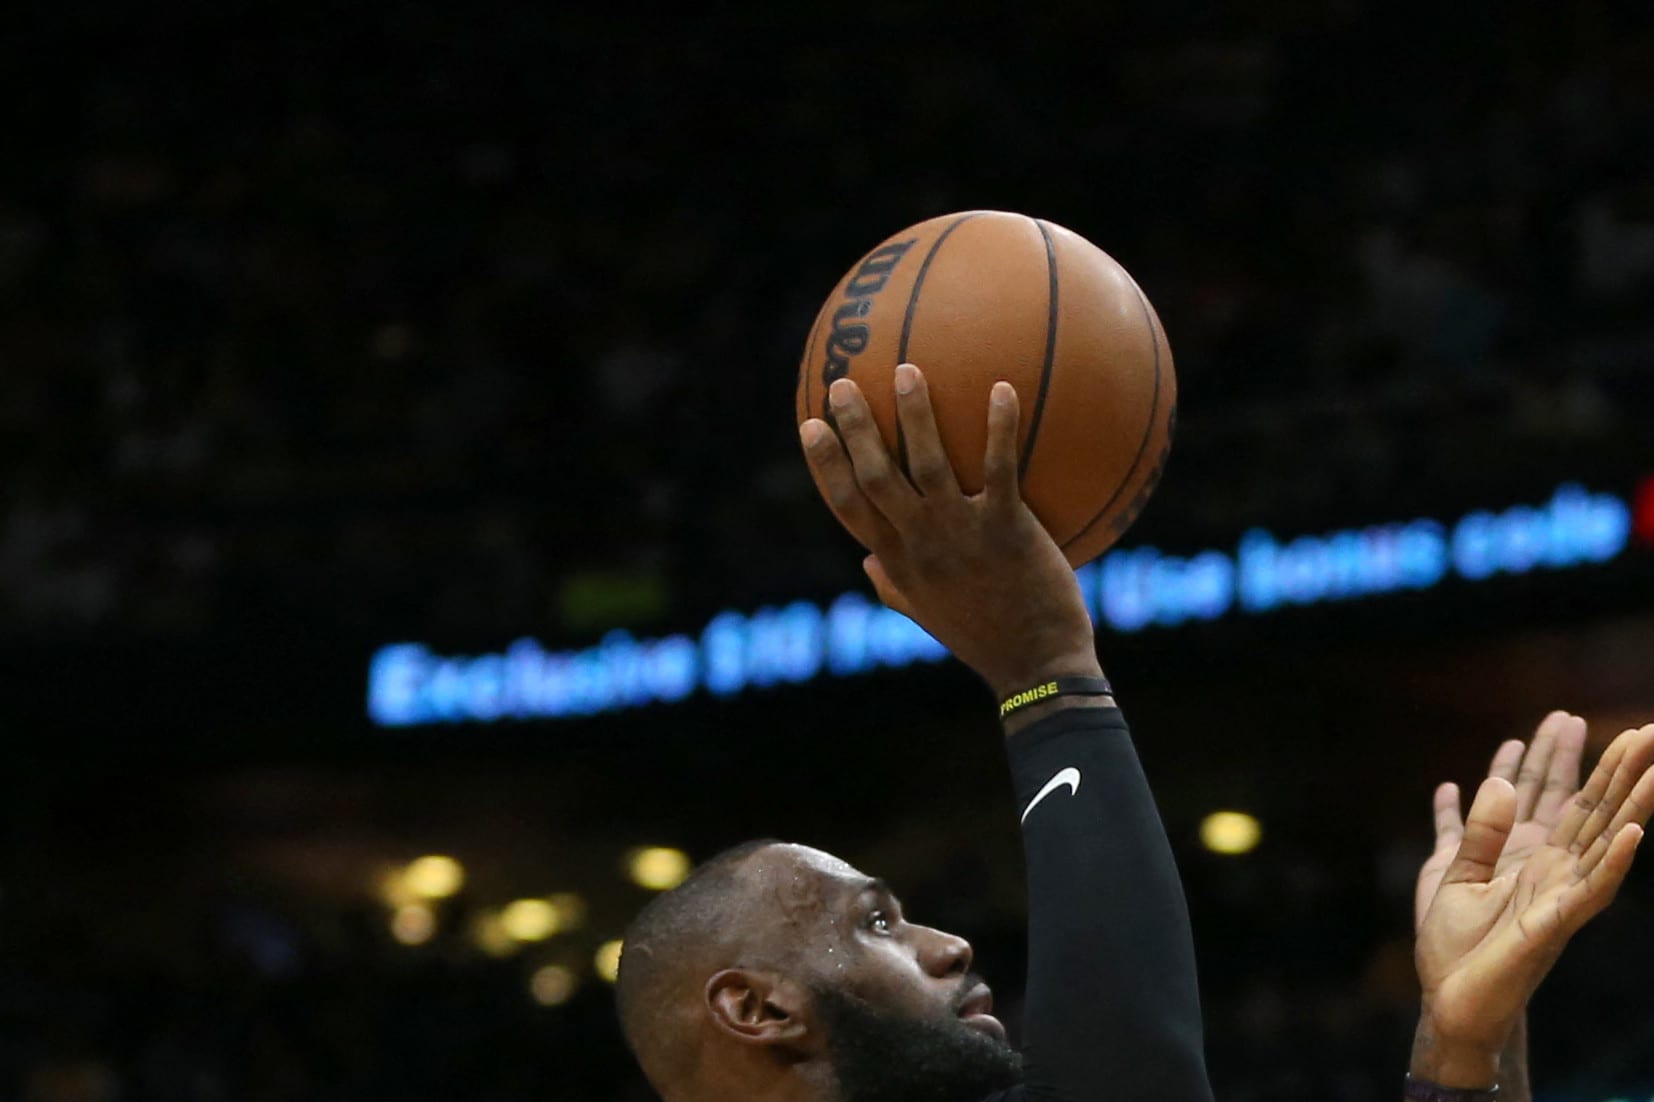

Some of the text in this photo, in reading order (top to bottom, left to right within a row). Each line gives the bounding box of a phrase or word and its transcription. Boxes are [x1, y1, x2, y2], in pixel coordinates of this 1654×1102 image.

[367, 631, 699, 726] Exclusive
[1100, 549, 1235, 633] Use
[1238, 520, 1447, 612] bonus
[1452, 482, 1631, 580] code
[1000, 681, 1059, 716] PROMISE
